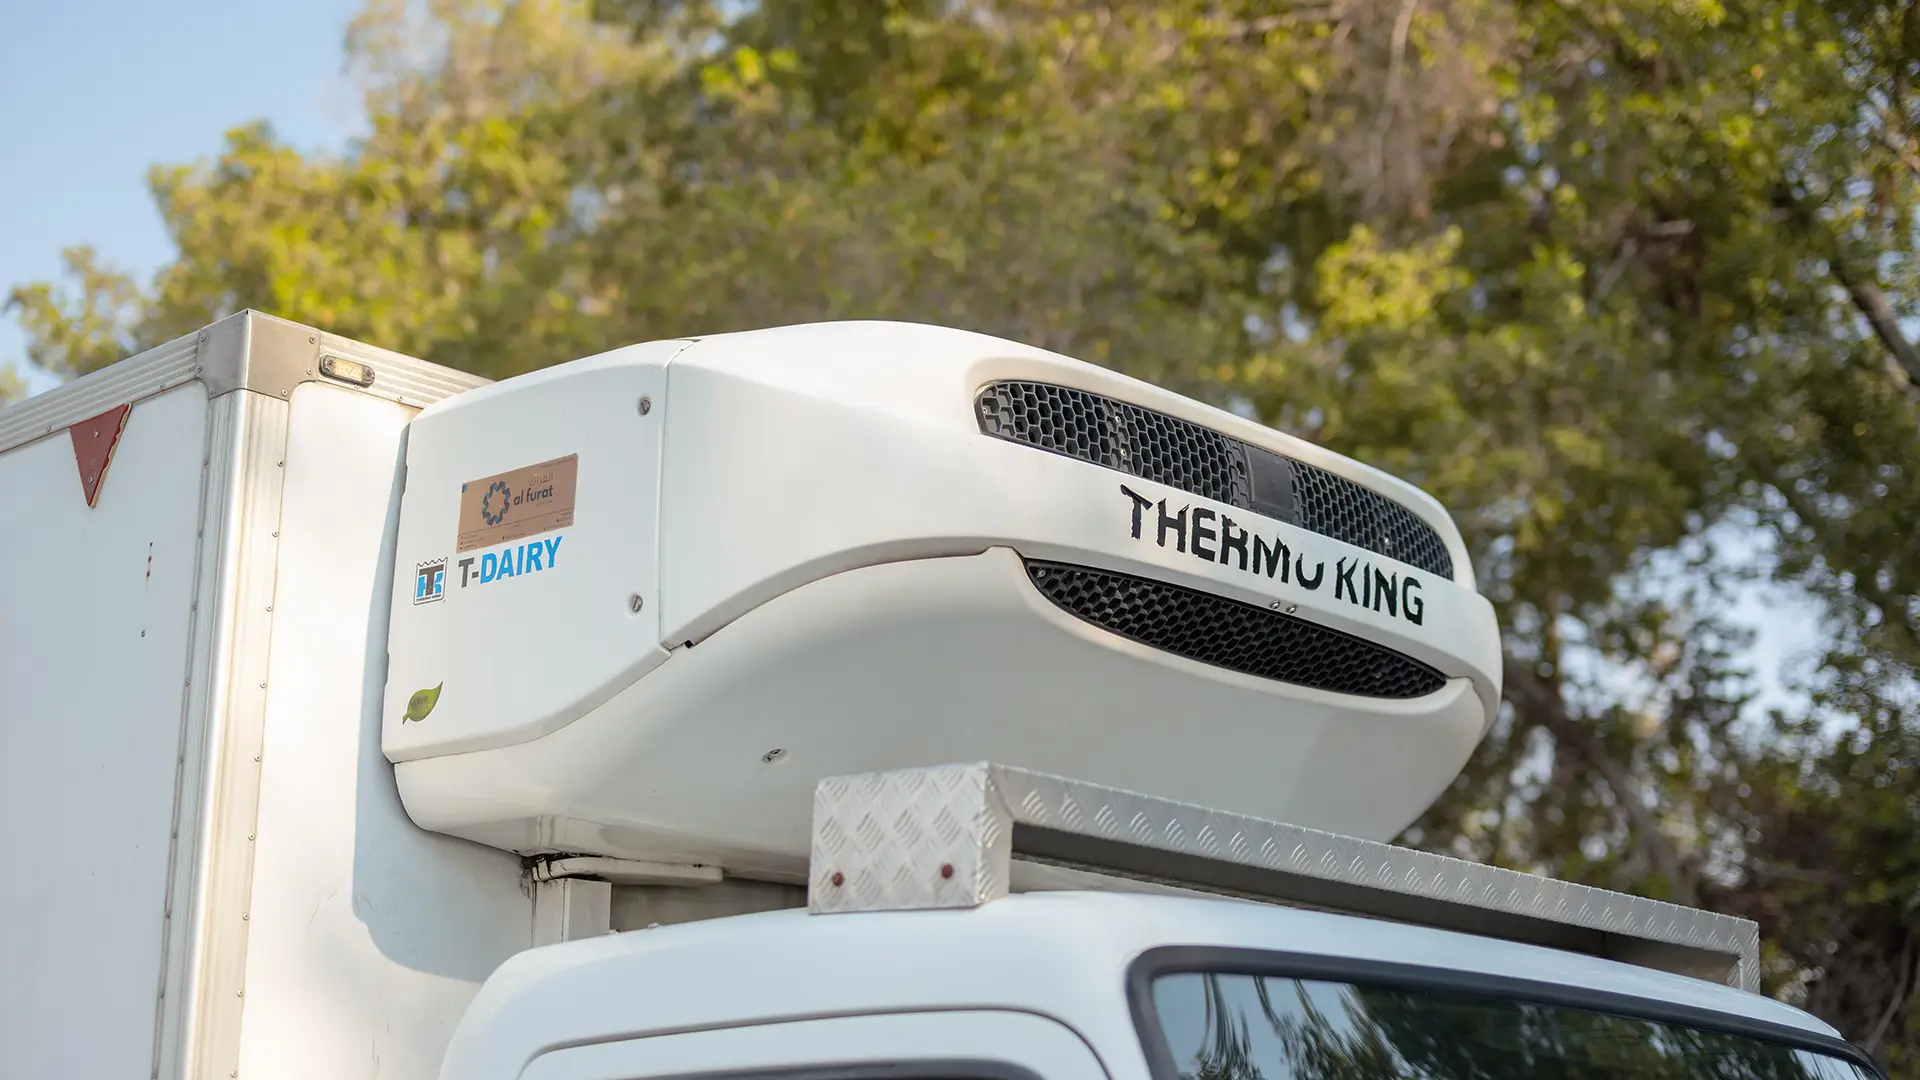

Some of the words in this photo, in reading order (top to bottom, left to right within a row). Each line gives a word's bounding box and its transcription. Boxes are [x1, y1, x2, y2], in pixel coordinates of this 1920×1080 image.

[514, 490, 524, 505] al
[526, 485, 553, 502] furat
[458, 536, 563, 588] T-DAIRY
[1335, 556, 1424, 626] KING
